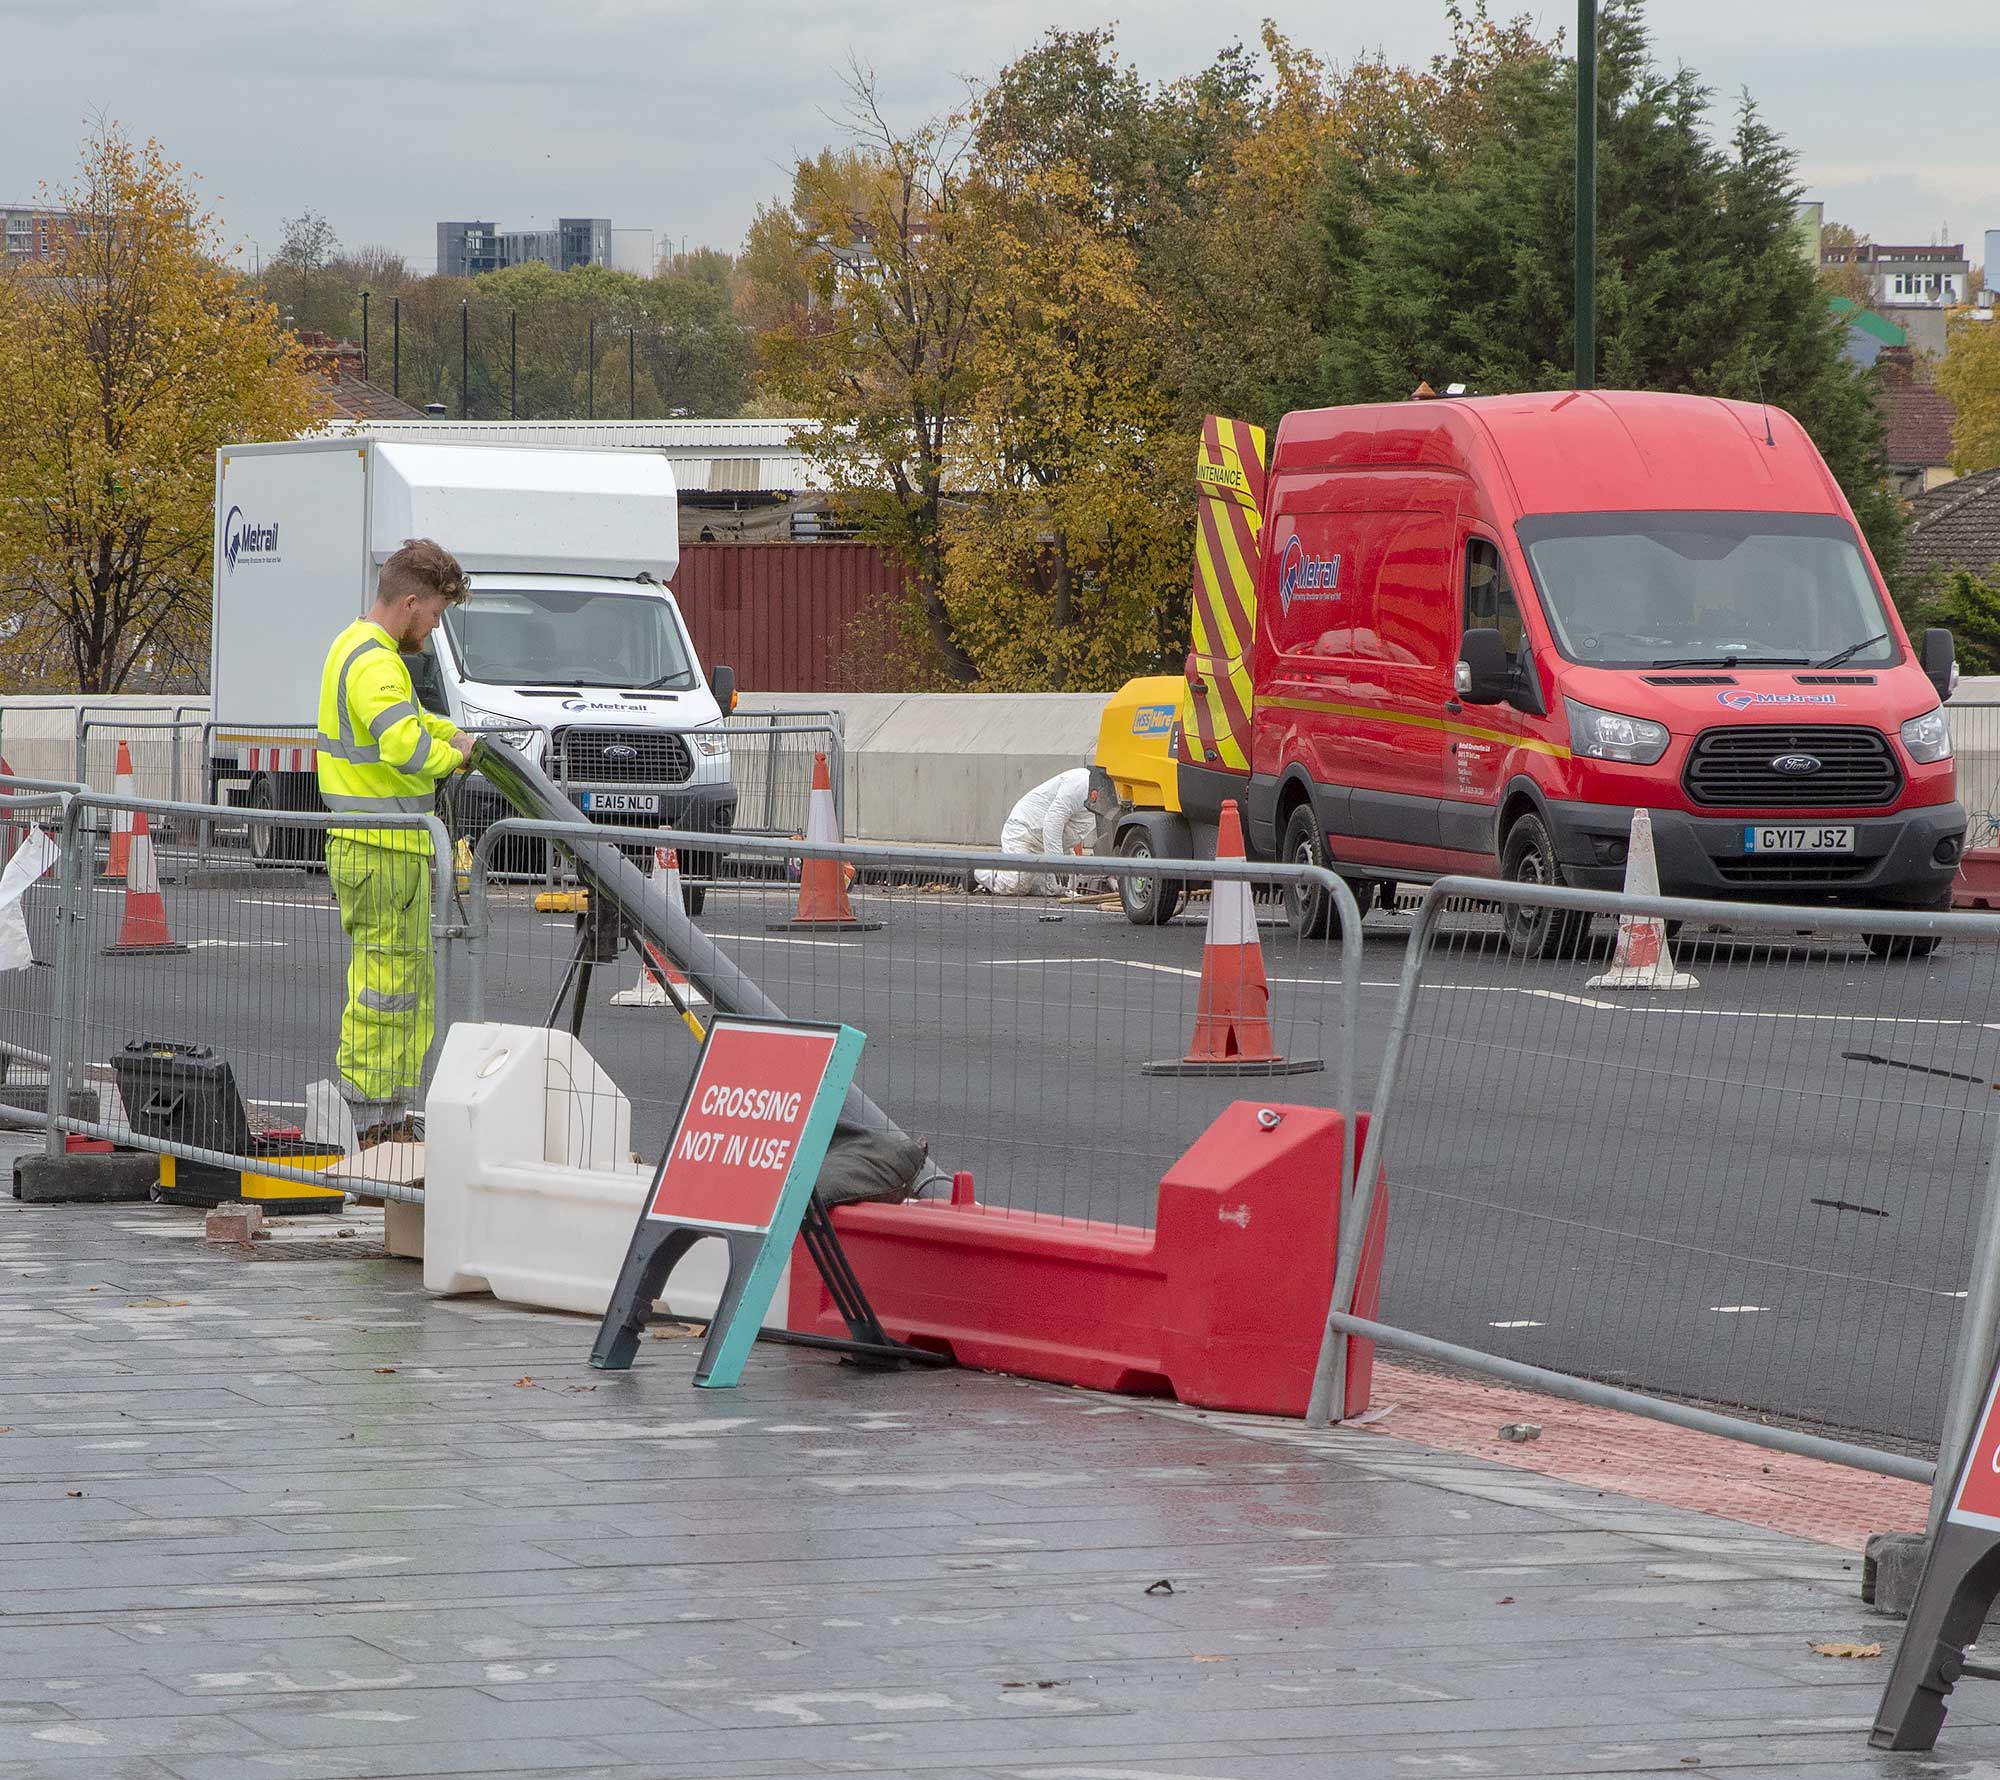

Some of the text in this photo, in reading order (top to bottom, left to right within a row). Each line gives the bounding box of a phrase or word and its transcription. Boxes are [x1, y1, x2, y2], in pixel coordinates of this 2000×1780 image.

[241, 522, 279, 552] Metrail
[1297, 553, 1341, 589] Metrail
[590, 703, 647, 711] Metrail
[1757, 694, 1836, 704] Metrail
[1785, 758, 1811, 770] Ford
[595, 795, 654, 810] EA15 NLO
[1763, 829, 1847, 849] GY17 JSZ
[701, 1085, 801, 1123] CROSSING
[678, 1130, 791, 1170] NOT IN USE
